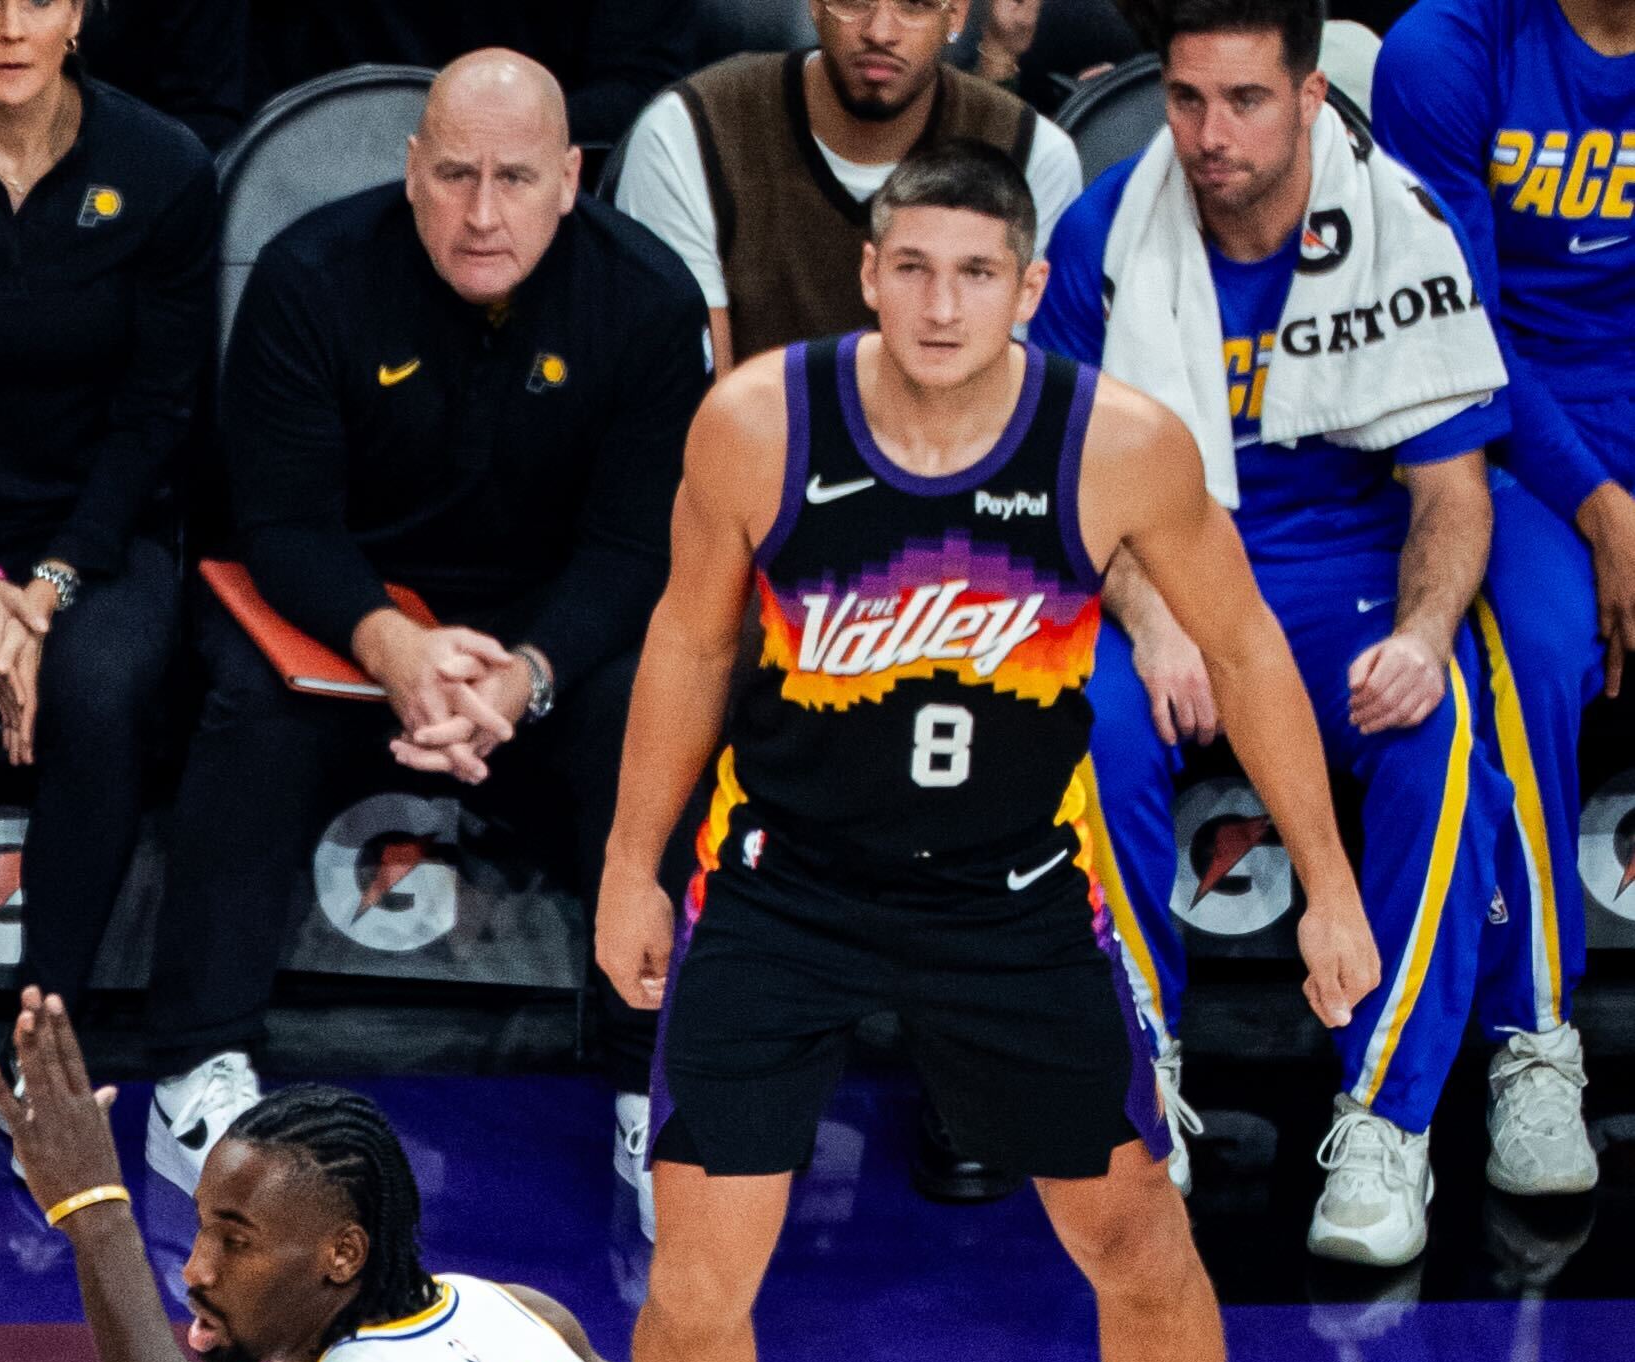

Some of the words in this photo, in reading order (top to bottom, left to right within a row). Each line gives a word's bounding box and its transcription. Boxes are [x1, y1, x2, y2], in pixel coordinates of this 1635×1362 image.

[974, 490, 1048, 521] PayPal
[797, 579, 1046, 677] Valley
[855, 594, 903, 622] THE
[911, 702, 974, 788] 8
